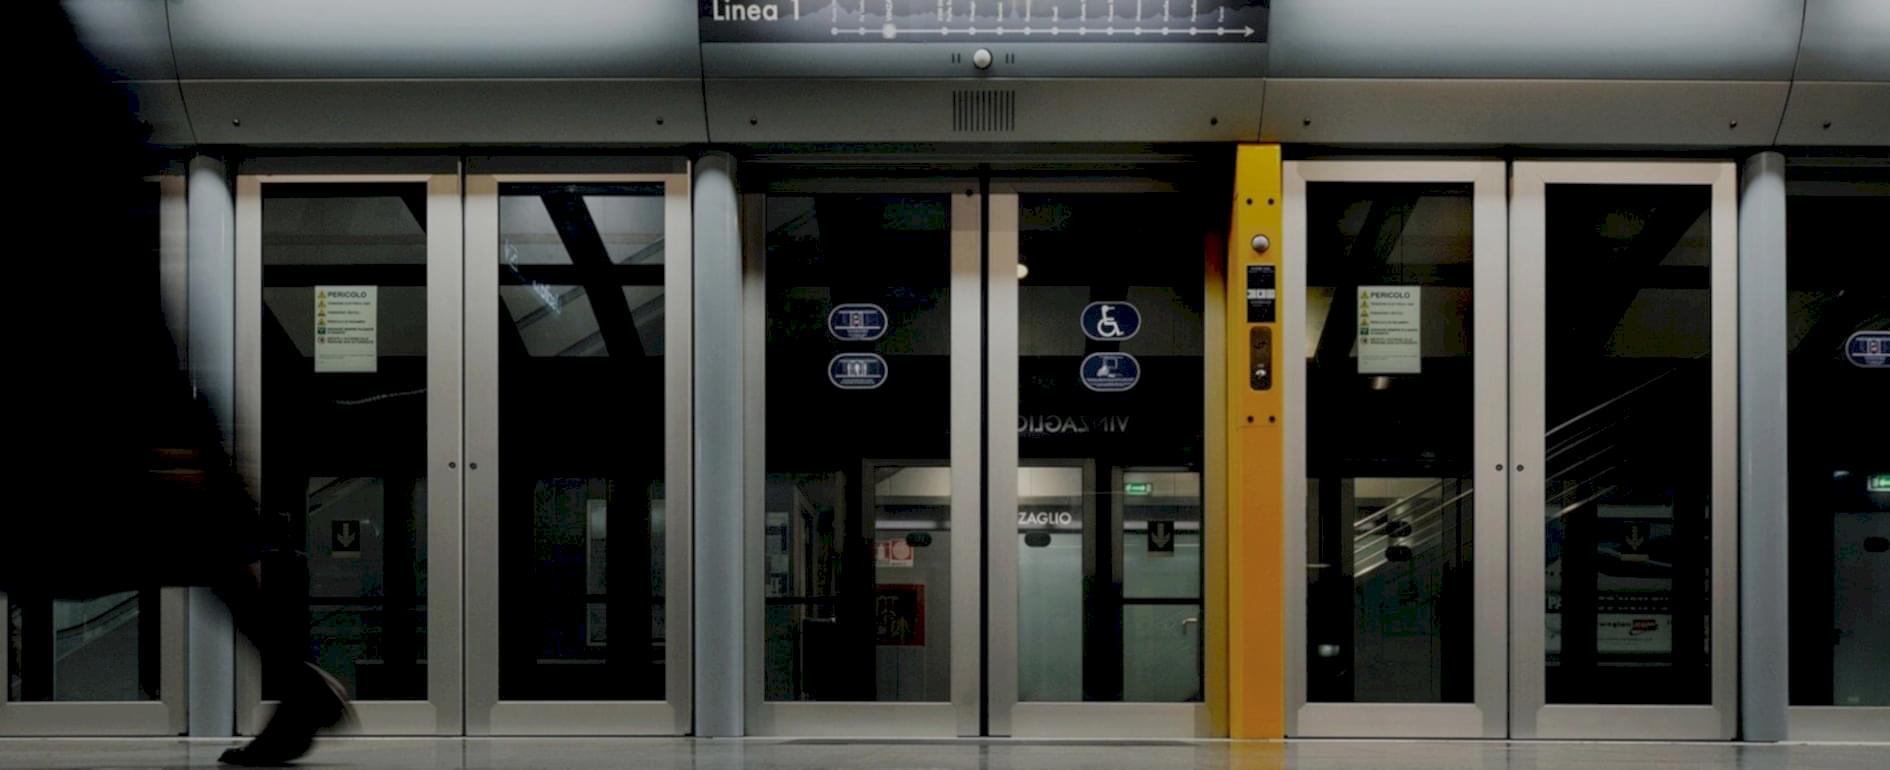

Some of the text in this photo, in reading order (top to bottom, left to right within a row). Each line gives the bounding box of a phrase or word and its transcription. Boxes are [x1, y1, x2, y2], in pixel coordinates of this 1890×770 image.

[713, 0, 800, 21] Linea 1
[327, 291, 367, 299] PERICOLO
[1370, 291, 1410, 300] PERICOLO
[1017, 511, 1072, 525] ZAGLIO
